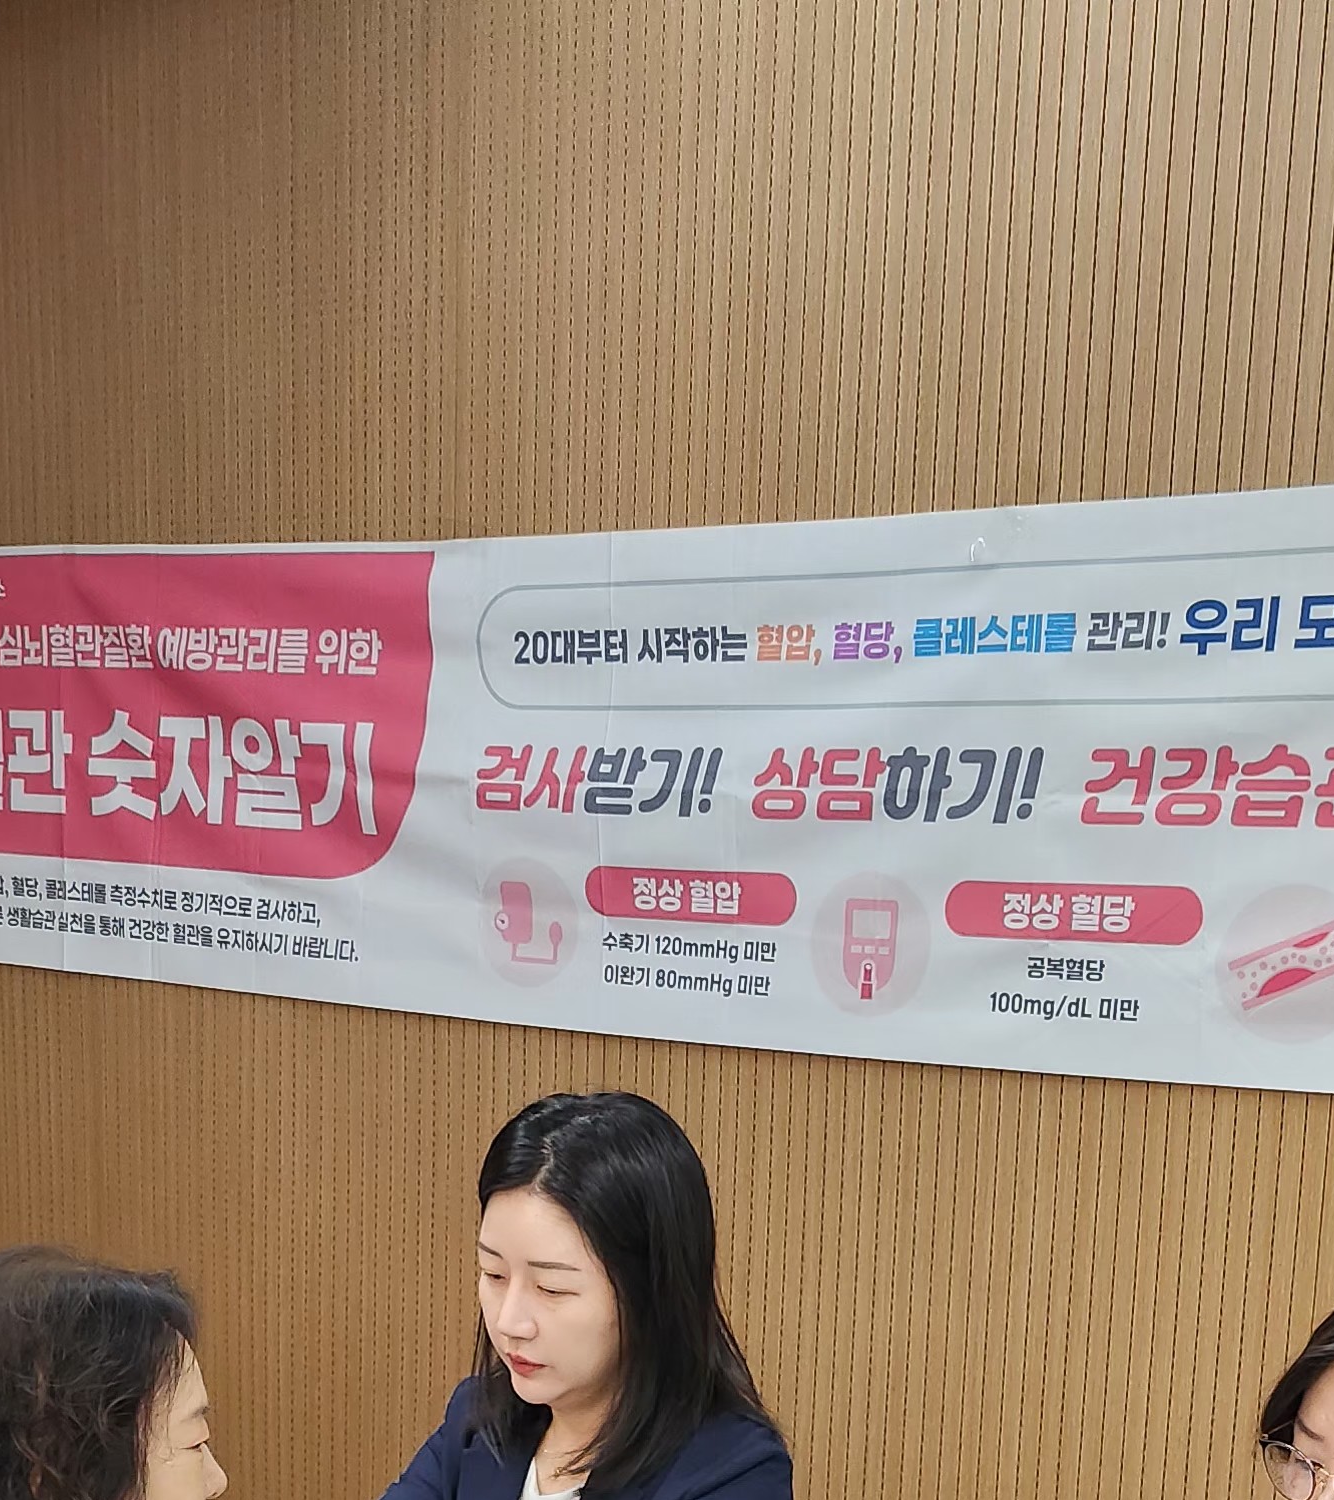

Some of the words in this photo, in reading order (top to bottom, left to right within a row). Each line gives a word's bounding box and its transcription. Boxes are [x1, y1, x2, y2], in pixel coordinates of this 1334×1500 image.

[158, 626, 309, 675] 예방관리를
[315, 627, 383, 677] 위한
[513, 627, 629, 666] 20대부터
[636, 624, 749, 666] 시작하는
[755, 622, 822, 666] 혈압,
[831, 619, 903, 664] 혈당,
[912, 611, 1077, 659] 콜레스테롤
[1086, 610, 1170, 653] 관리!
[1179, 595, 1280, 657] 우리
[86, 709, 379, 837] 숫자알기
[475, 743, 723, 818] 검사받기!
[750, 745, 1045, 825] 상담하기!
[11, 875, 43, 901] 혈당,
[45, 878, 107, 905] 콜레스테롤
[109, 883, 178, 912] 측정수치로
[180, 891, 253, 919] 정기적으로
[256, 898, 321, 928] 검사하고,
[632, 876, 683, 914] 정상
[689, 877, 742, 916] 혈압
[1003, 891, 1063, 931] 정상
[1070, 893, 1135, 933] 혈당
[99, 915, 125, 938] 통해
[128, 918, 169, 943] 건강한
[172, 922, 213, 948] 혈관을
[217, 926, 288, 956] 유지하시기
[292, 935, 360, 963] 바랍니다.
[602, 932, 650, 956] 수축기
[654, 935, 740, 965] 120mmHg
[744, 939, 777, 963] 미만
[603, 965, 650, 989] 이완기
[654, 969, 733, 997] 80mmHg
[737, 974, 771, 997] 미만
[1027, 956, 1105, 982] 공복혈당
[989, 991, 1092, 1021] 100mg/dL
[1099, 998, 1140, 1024] 미만
